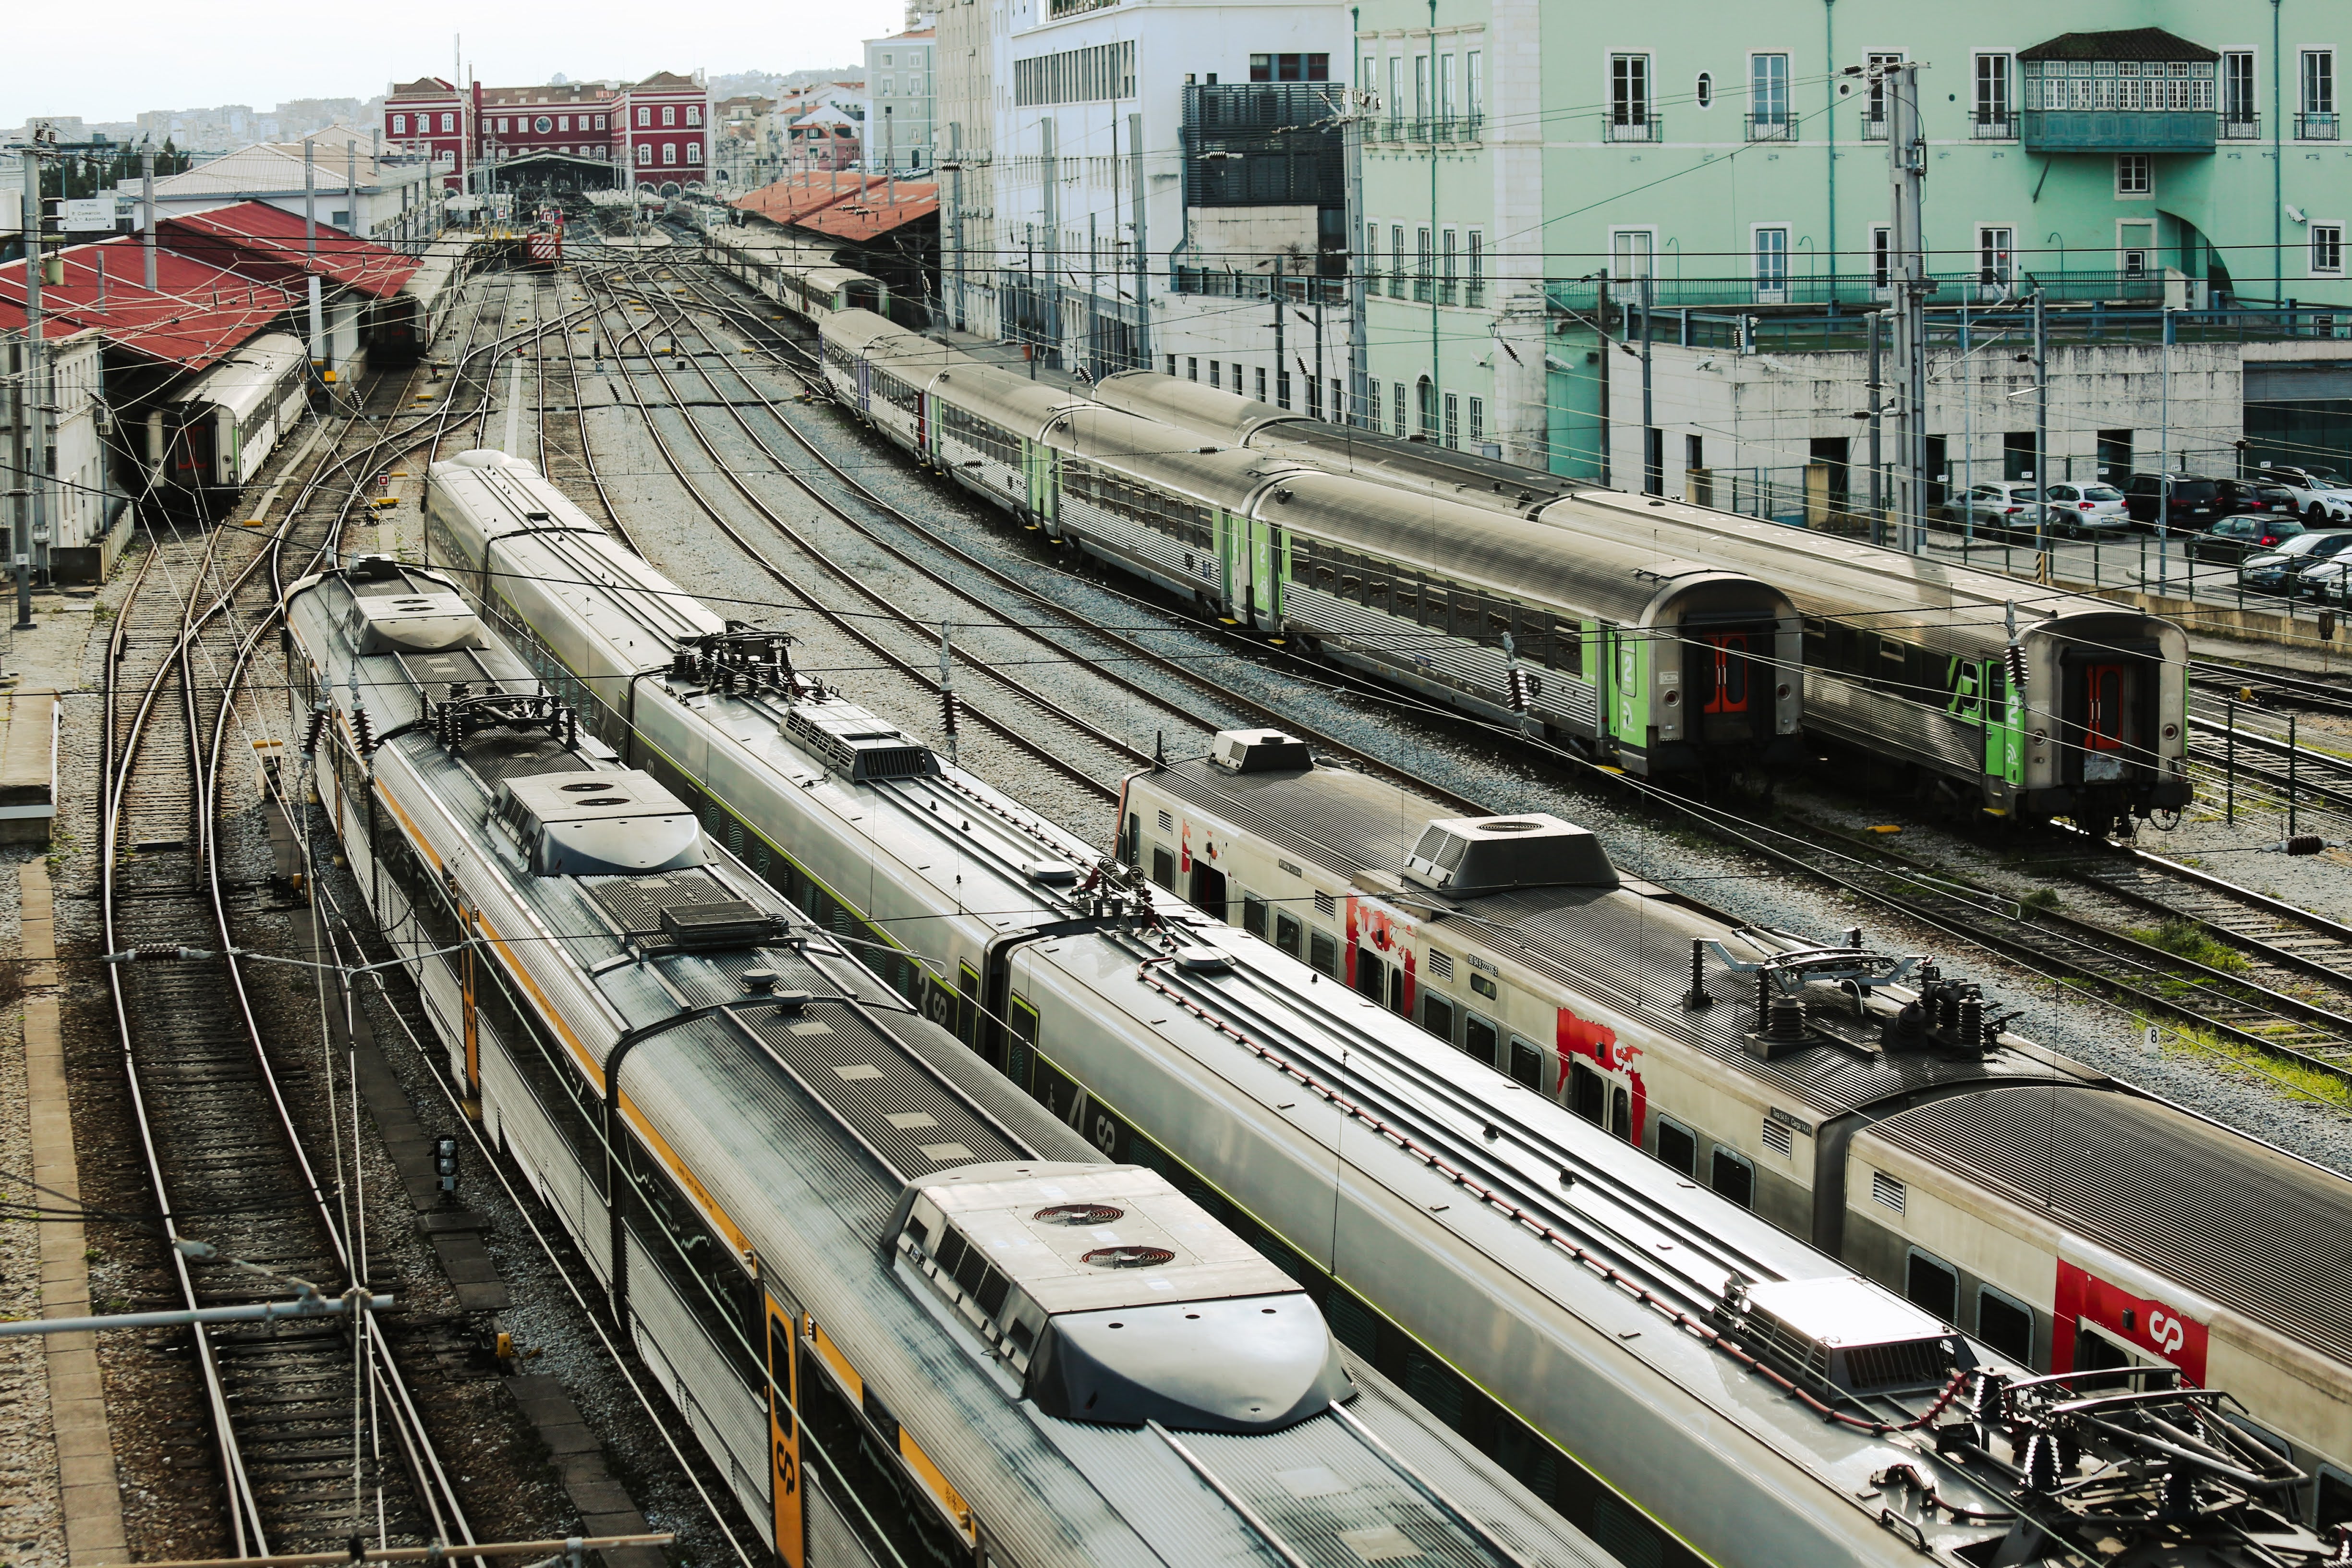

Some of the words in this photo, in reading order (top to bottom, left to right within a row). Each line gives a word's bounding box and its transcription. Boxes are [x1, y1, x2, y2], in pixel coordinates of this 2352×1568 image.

[1355, 215, 1359, 231] 39
[1260, 543, 1265, 563] 2
[1624, 655, 1632, 682] 2
[2008, 695, 2019, 725] 2
[1468, 954, 1473, 964] 90
[1474, 957, 1479, 967] 94
[933, 992, 947, 1025] CP
[2151, 1029, 2157, 1043] 8
[1096, 1115, 1115, 1155] CP
[1791, 1118, 1801, 1130] Carga
[2149, 1311, 2184, 1355] CP
[776, 1440, 795, 1496] CP
